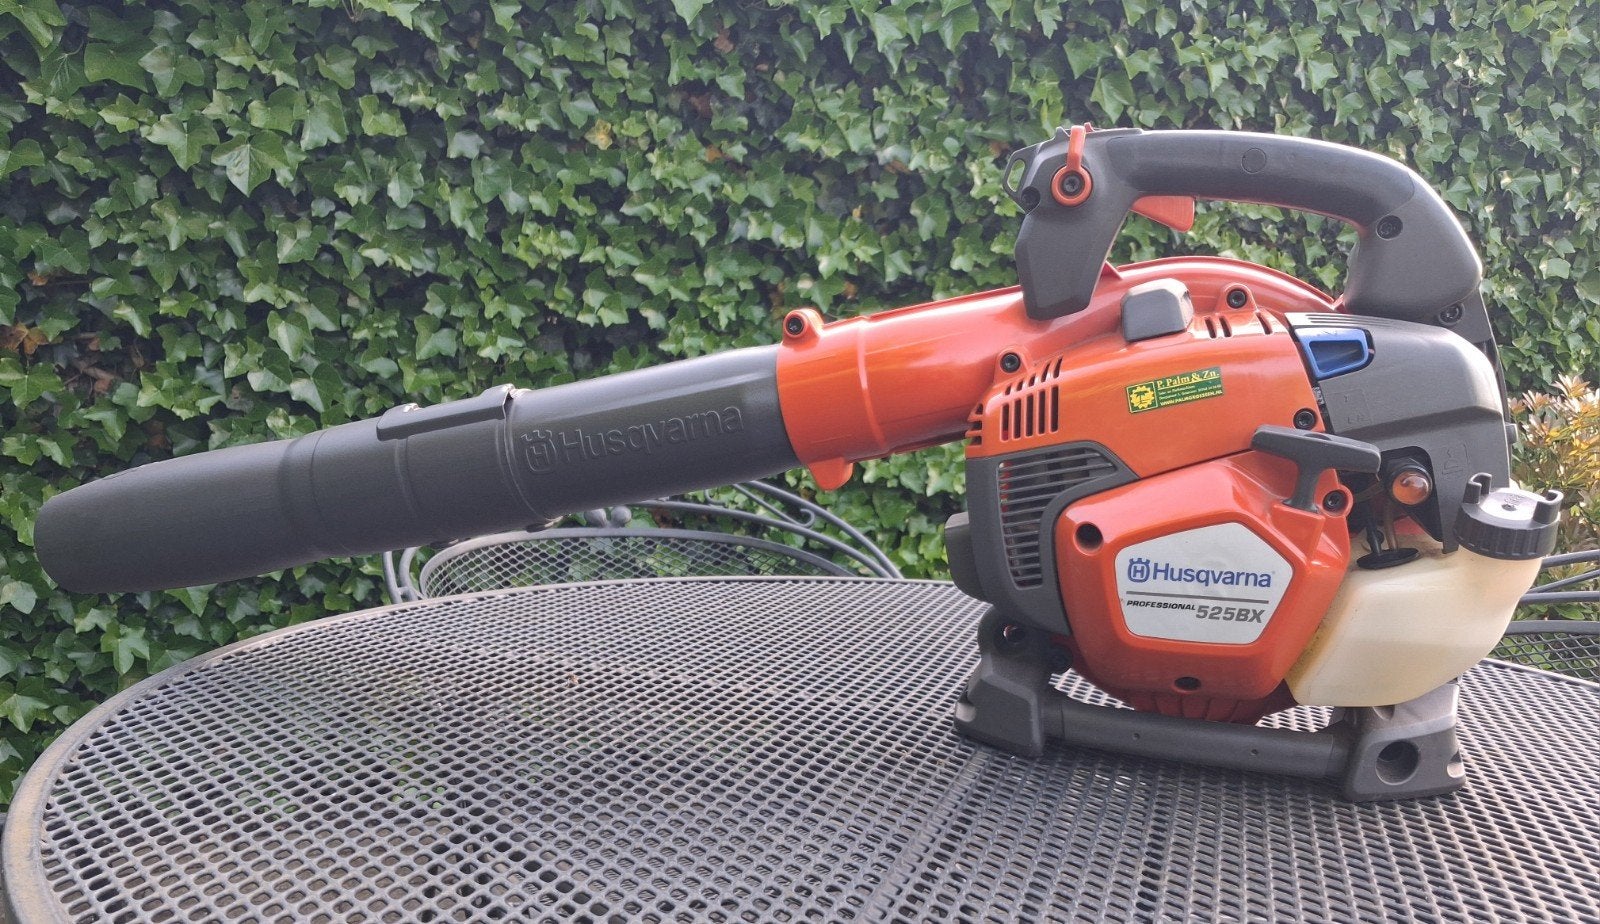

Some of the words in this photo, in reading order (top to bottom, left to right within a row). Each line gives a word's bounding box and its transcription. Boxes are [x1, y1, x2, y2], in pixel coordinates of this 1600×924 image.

[1157, 380, 1165, 389] P.
[1166, 376, 1190, 387] Palm
[1191, 372, 1203, 382] &
[1203, 370, 1220, 379] Zn.
[558, 405, 744, 463] Husqvarna
[1152, 562, 1272, 588] Husqvarna
[1126, 599, 1196, 611] PROFESSIONAL
[1195, 604, 1266, 624] 525BX
